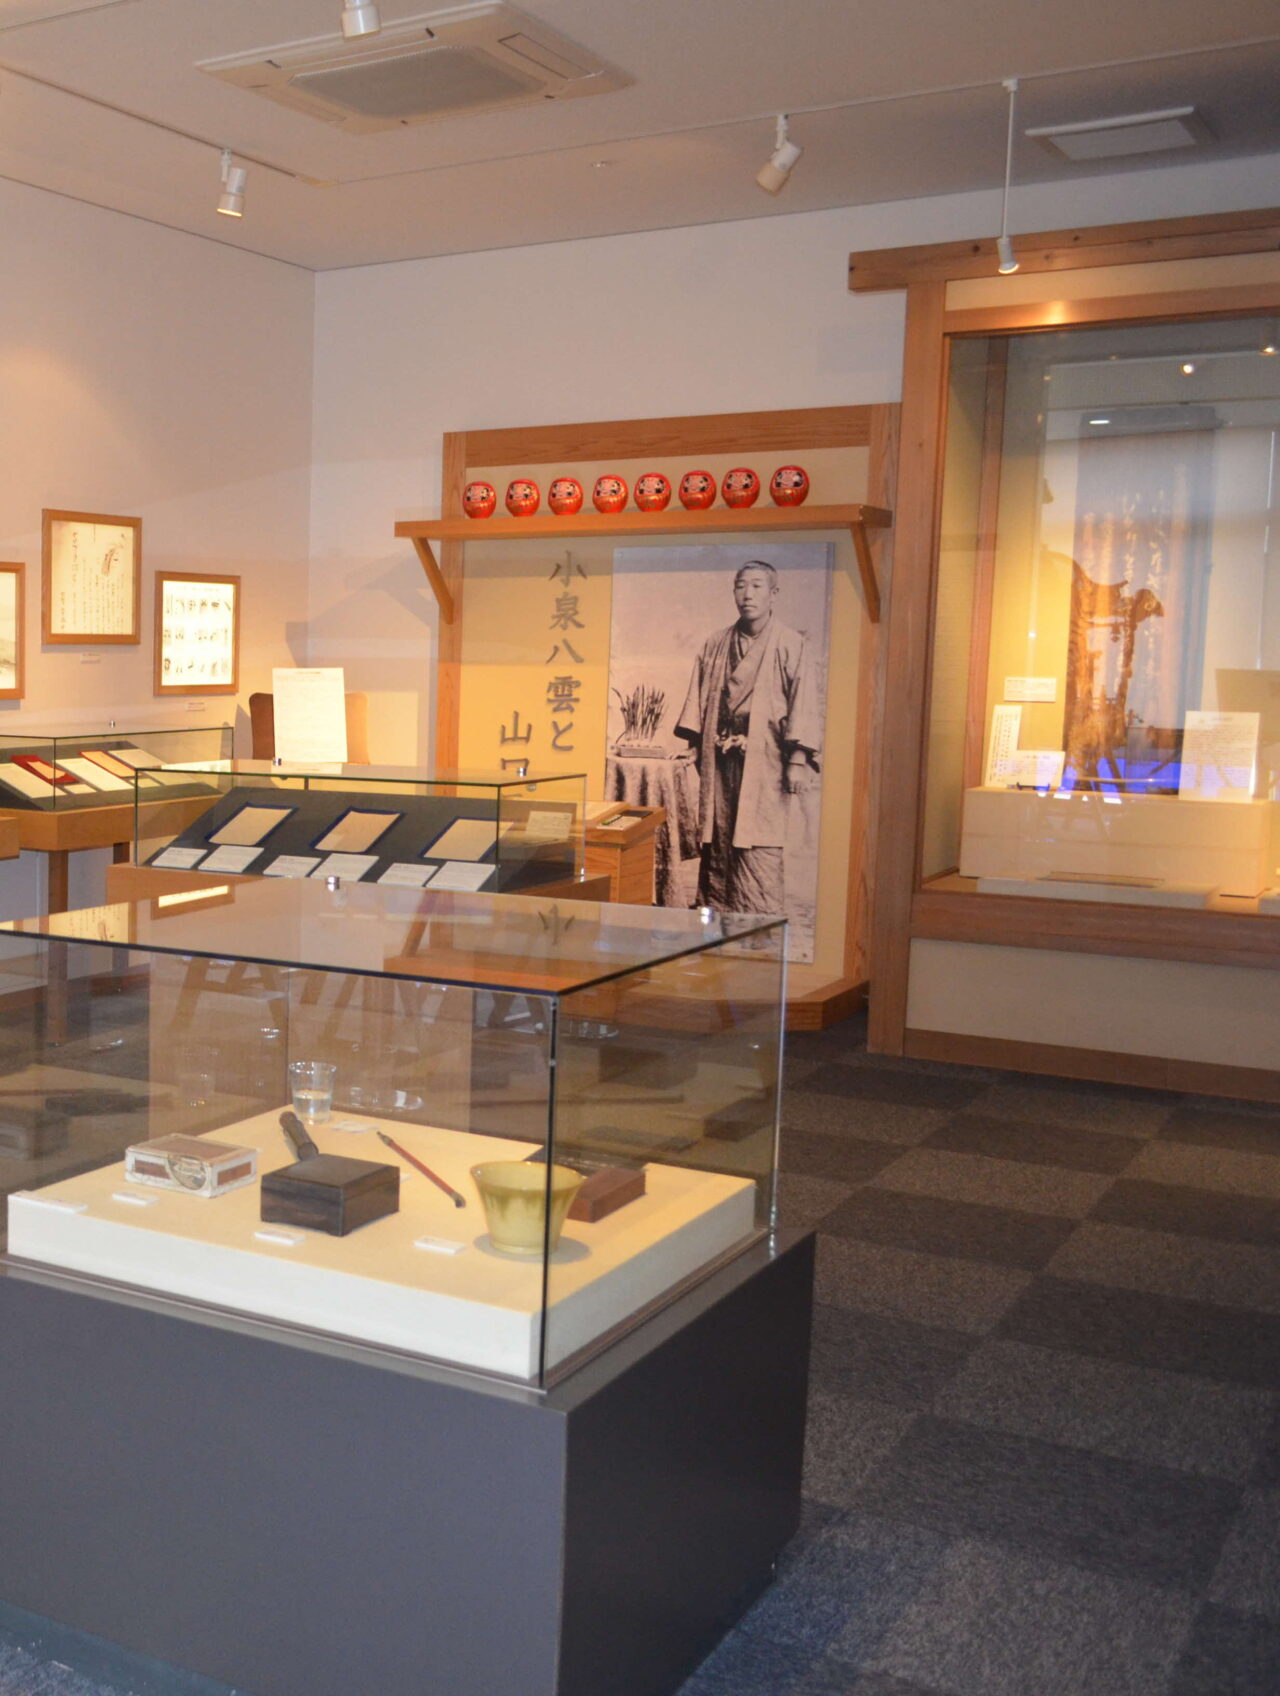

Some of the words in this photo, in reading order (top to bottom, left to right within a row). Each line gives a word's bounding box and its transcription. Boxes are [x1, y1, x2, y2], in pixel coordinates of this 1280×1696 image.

[545, 550, 588, 752] 小泉八雲と
